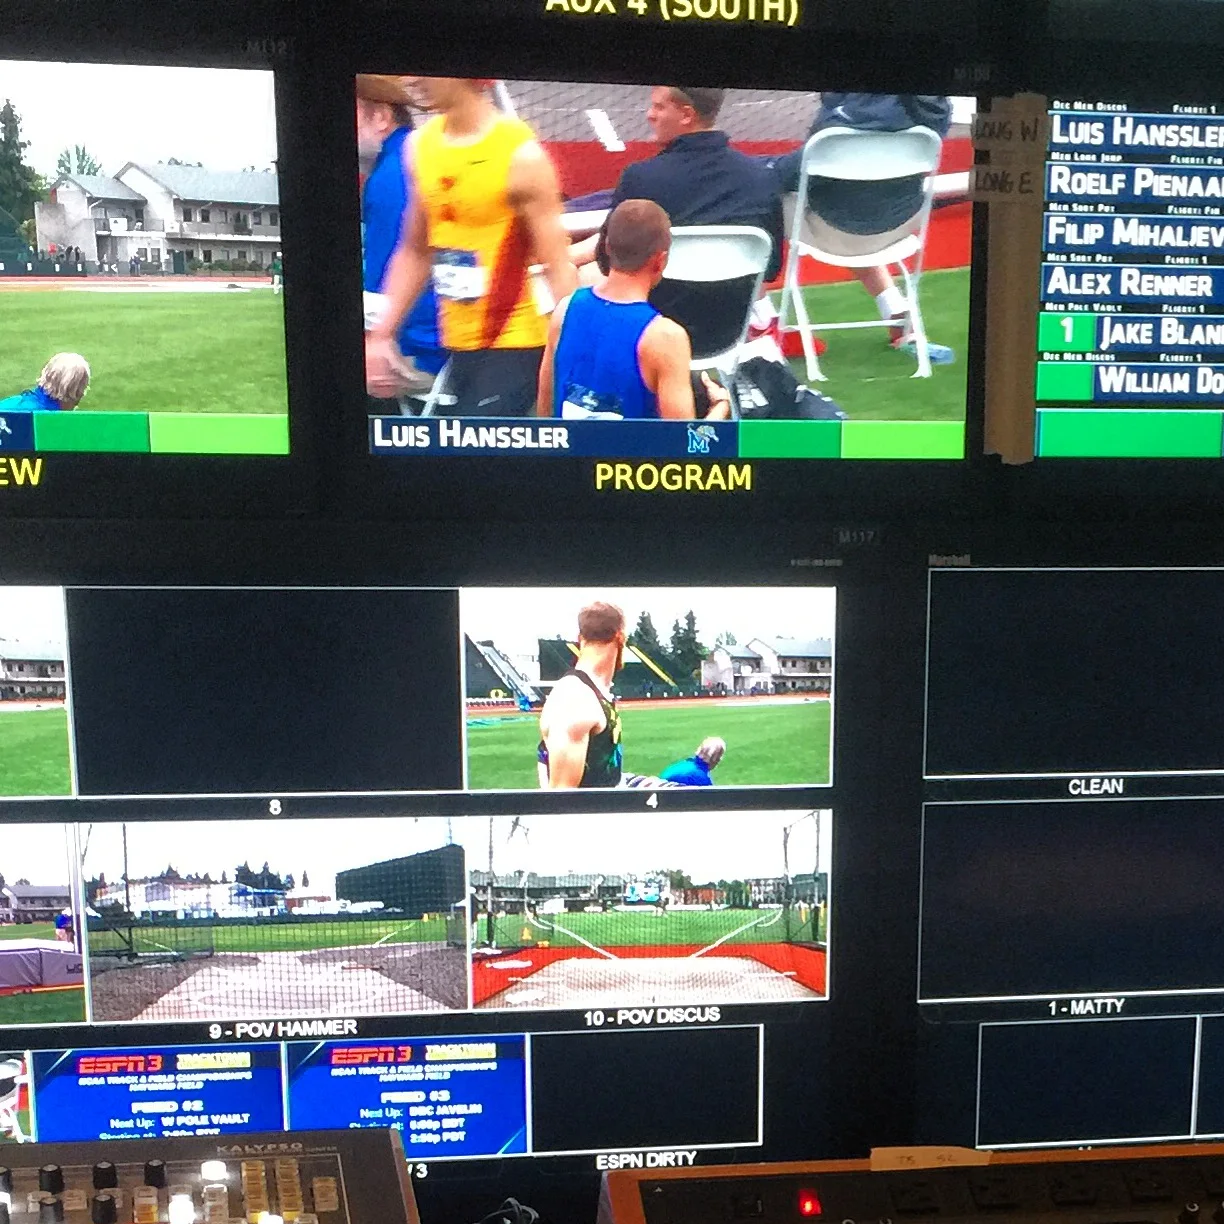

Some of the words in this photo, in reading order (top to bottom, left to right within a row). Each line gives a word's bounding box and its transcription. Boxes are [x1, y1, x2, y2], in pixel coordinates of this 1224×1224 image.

[1052, 115, 1104, 145] LUIS
[1050, 165, 1126, 195] ROELF
[1048, 216, 1104, 245] FILIP
[1047, 267, 1112, 295] ALEX
[1120, 268, 1213, 297] RENNER
[1060, 317, 1073, 342] 1
[1100, 316, 1153, 351] JAKE
[1099, 366, 1190, 394] WILLIAM
[374, 418, 430, 447] LUIS
[438, 419, 569, 449] HANSSLER
[595, 464, 752, 491] PROGRAM
[1069, 777, 1124, 795] CLEAN
[269, 799, 281, 815] 8
[646, 793, 659, 808] 4
[584, 1010, 604, 1025] 10
[617, 1008, 653, 1024] POV
[656, 1006, 720, 1024] DISCUS
[1048, 1001, 1056, 1016] 1
[1071, 999, 1124, 1016] MATTY
[209, 1022, 220, 1038] 9
[236, 1020, 273, 1037] POV
[278, 1018, 358, 1037] HAMMER
[217, 1142, 303, 1154] KALYPSO
[596, 1153, 643, 1170] ESPN
[646, 1151, 697, 1169] DIRTY
